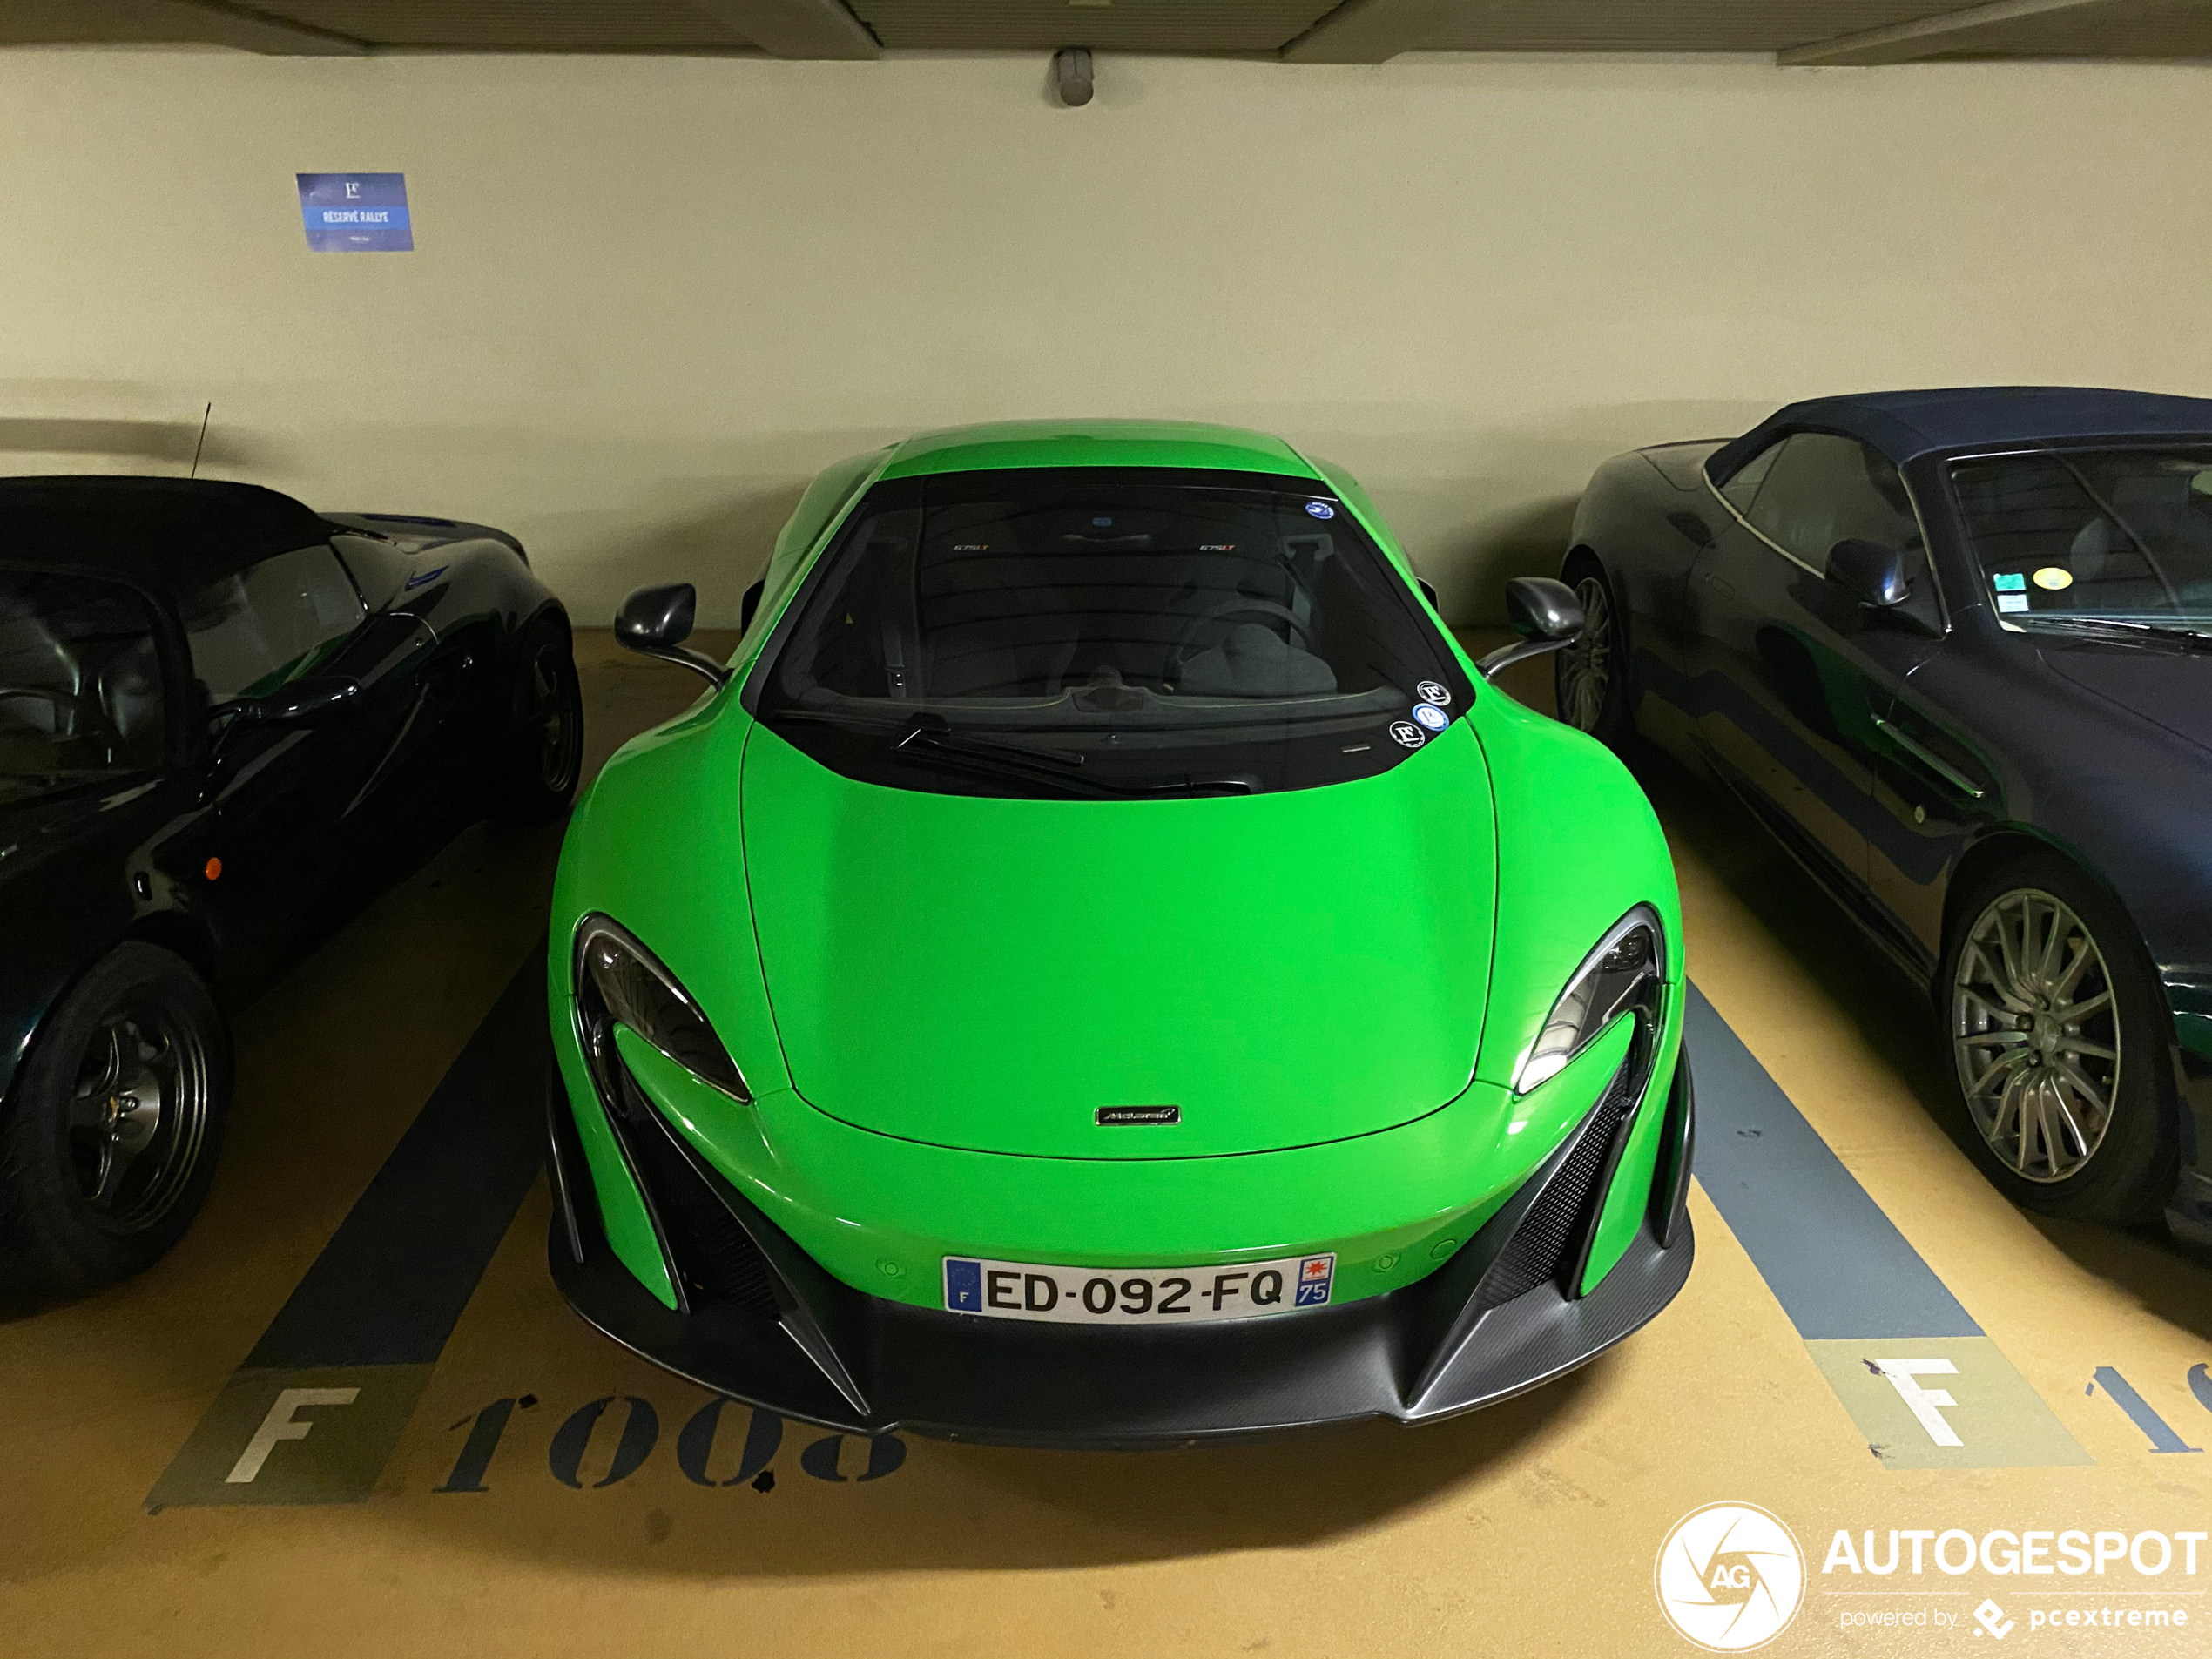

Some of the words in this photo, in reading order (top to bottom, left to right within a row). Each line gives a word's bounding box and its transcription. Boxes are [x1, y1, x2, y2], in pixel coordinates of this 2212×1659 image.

[360, 212, 388, 223] RALLYE
[1103, 1111, 1170, 1121] McLaren
[960, 1291, 969, 1303] F
[987, 1270, 1283, 1314] ED-092-FQ
[1299, 1283, 1326, 1303] 75
[1875, 1358, 1964, 1447] F
[225, 1387, 361, 1483] F
